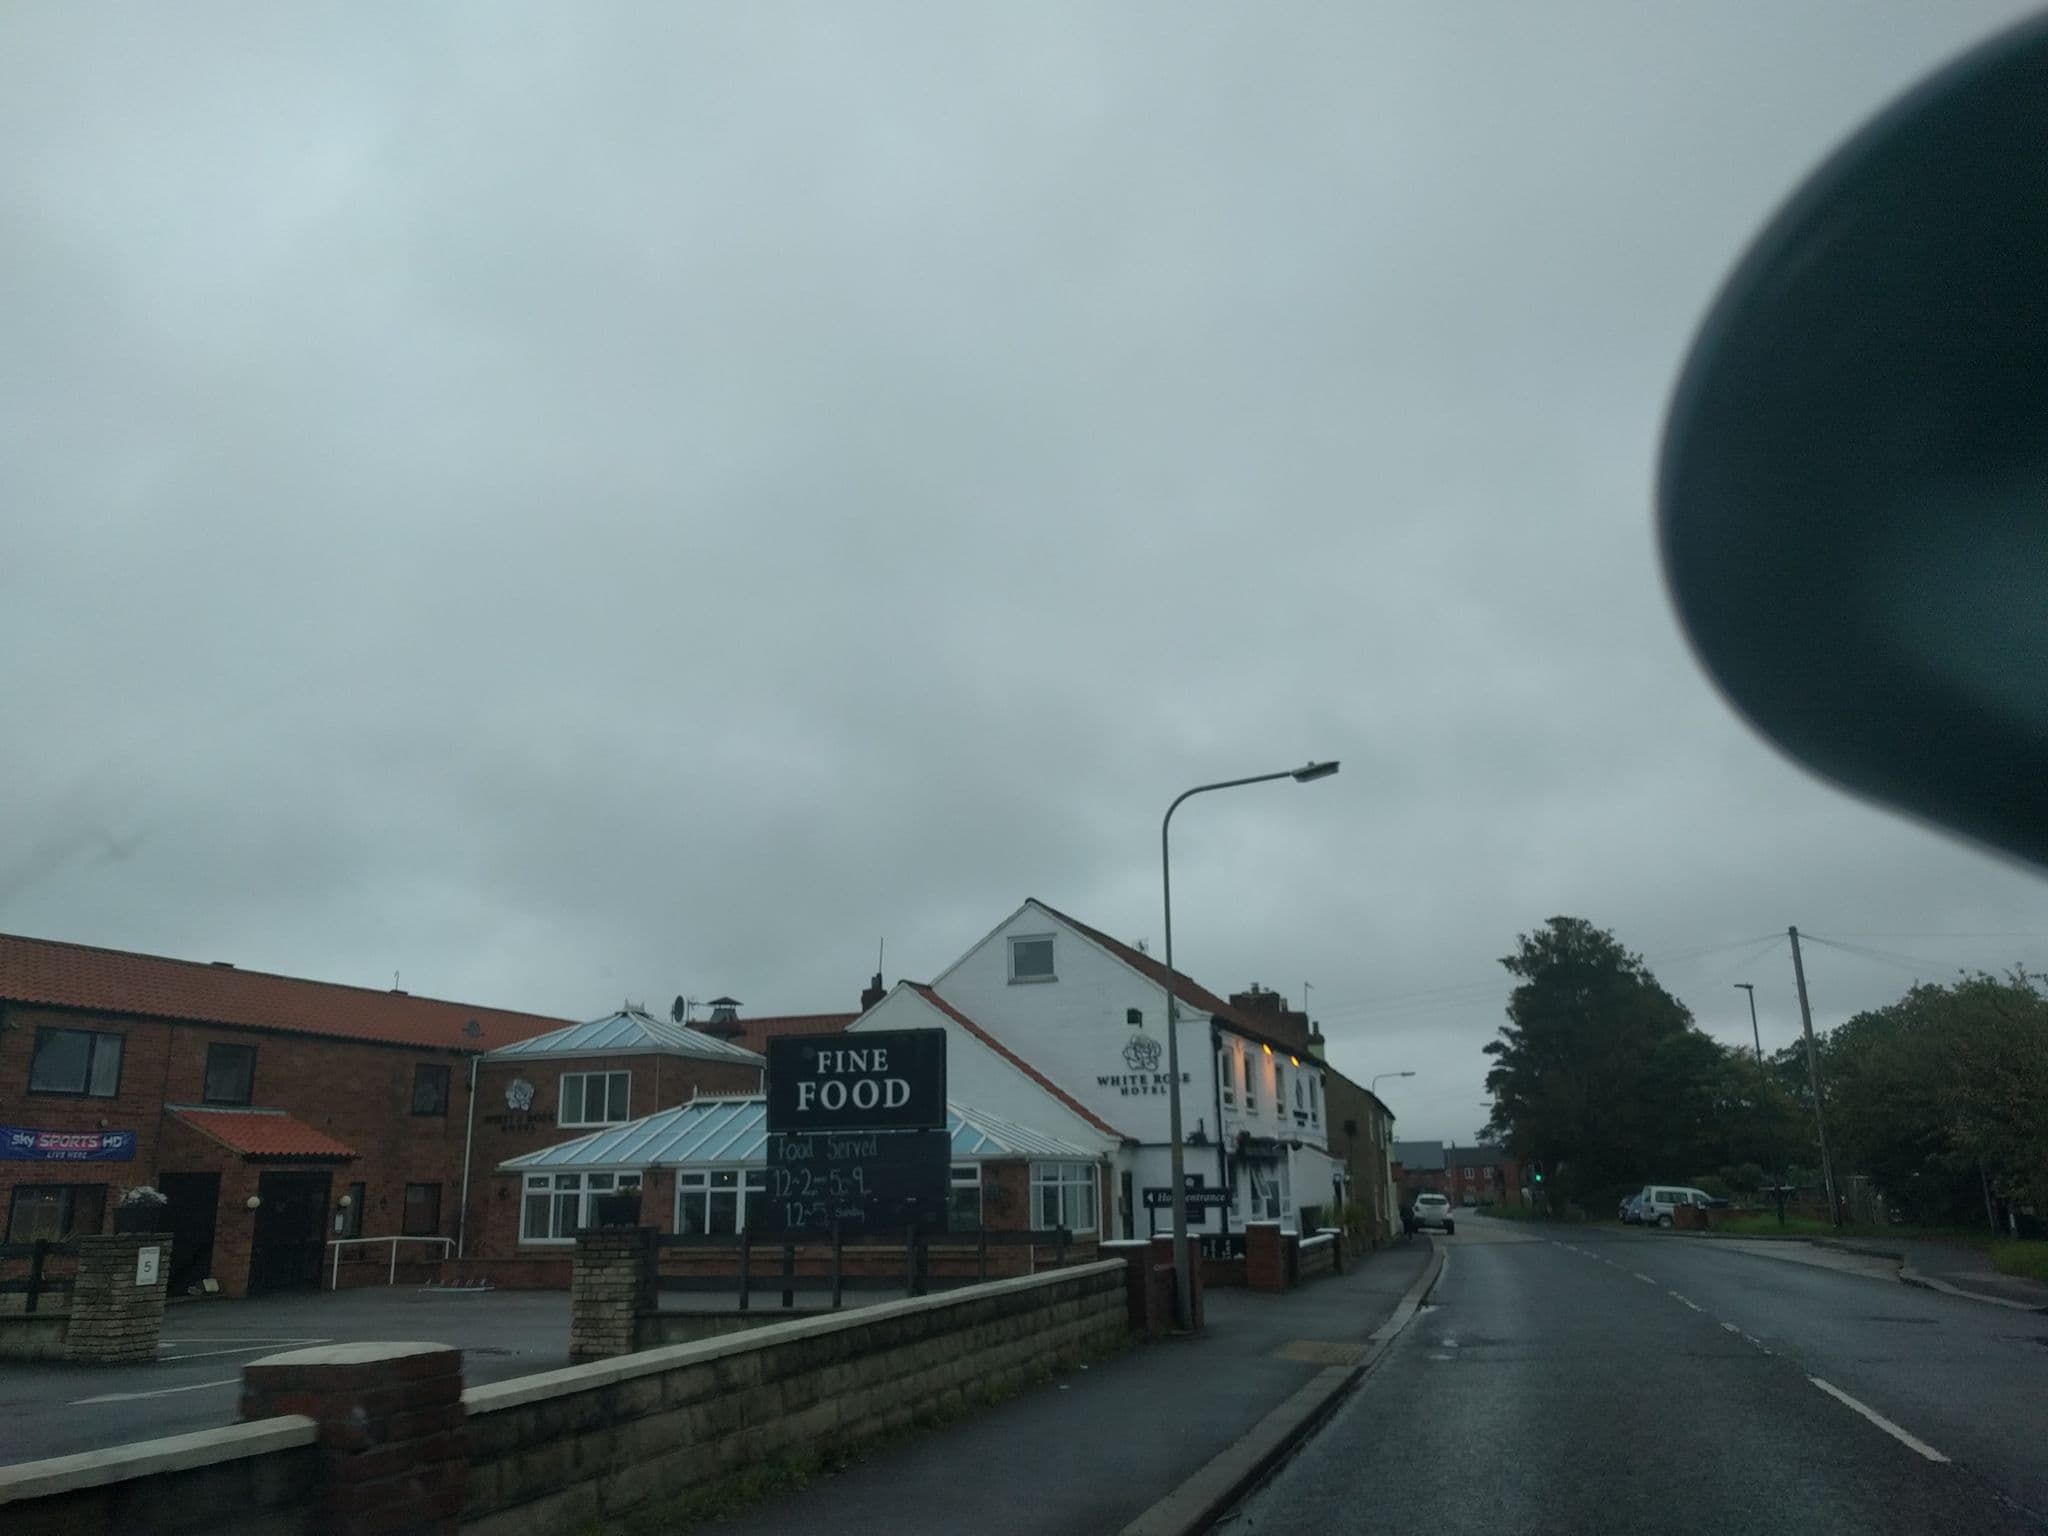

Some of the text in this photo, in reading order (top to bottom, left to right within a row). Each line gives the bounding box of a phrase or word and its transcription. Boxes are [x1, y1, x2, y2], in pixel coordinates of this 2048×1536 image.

[817, 1049, 888, 1073] FINE
[1097, 1073, 1192, 1086] WHITE ROE
[797, 1079, 911, 1111] FOOD
[1121, 1085, 1167, 1096] HOTEL
[11, 1132, 123, 1148] sky SPORTS HD
[777, 1135, 878, 1161] Food Served
[143, 1260, 152, 1273] 5
